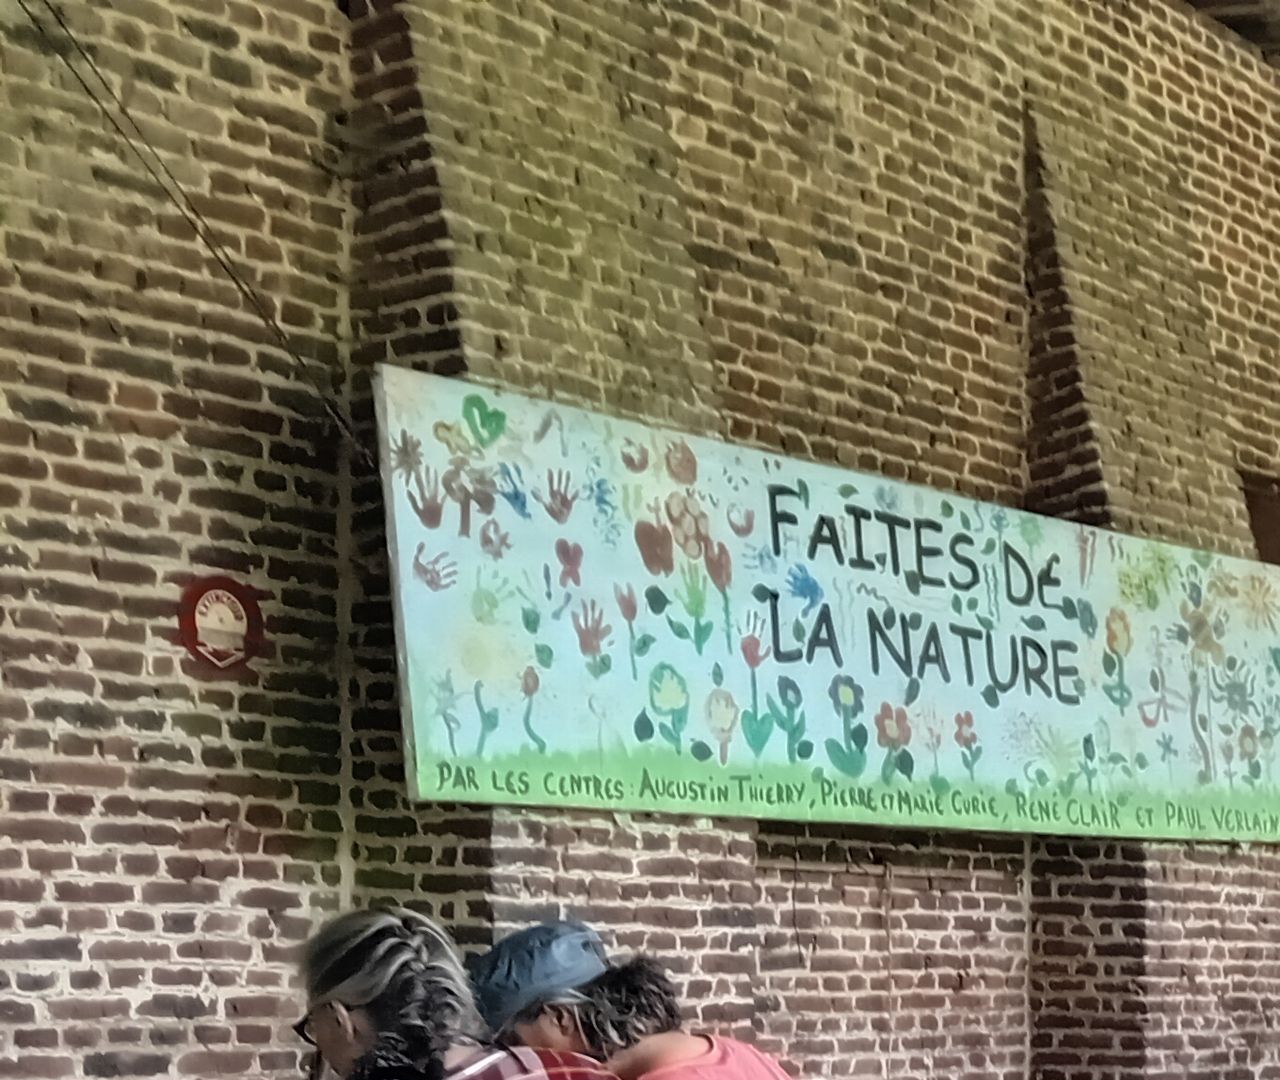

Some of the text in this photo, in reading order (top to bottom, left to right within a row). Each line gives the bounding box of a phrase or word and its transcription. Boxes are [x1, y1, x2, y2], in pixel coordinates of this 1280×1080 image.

[767, 484, 1064, 609] FAITES DE
[769, 589, 1080, 704] LA NATURE
[436, 761, 479, 792] PAR
[492, 770, 530, 795] LES
[1136, 807, 1154, 828] ET
[1166, 801, 1206, 831] PAUL
